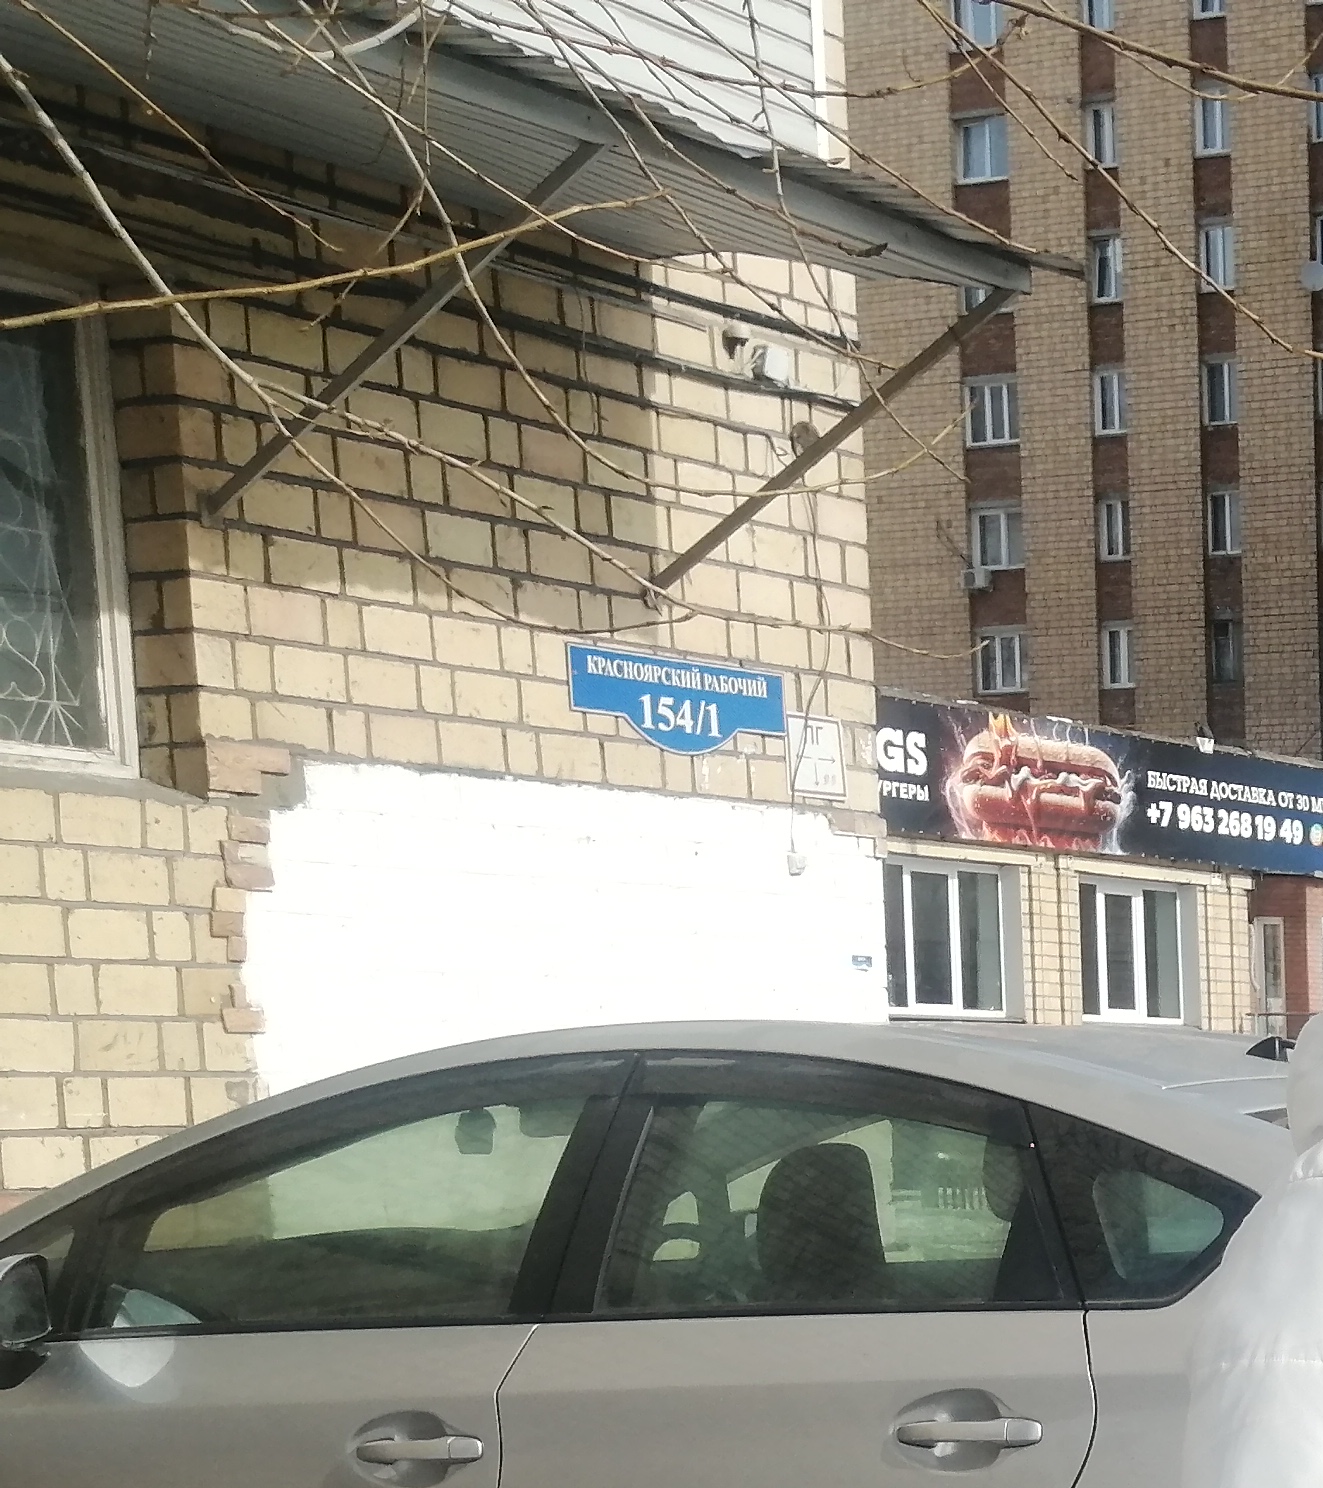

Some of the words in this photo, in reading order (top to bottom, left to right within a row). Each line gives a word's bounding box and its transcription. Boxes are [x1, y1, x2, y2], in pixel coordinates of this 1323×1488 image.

[586, 655, 701, 690] КРАСНОЯРСКИЙ
[703, 675, 768, 698] РАБОЧИЙ
[639, 693, 723, 738] 154/1
[1146, 770, 1208, 797] БЫСТРАЯ
[1209, 781, 1277, 808] ДОСТАВКА
[1277, 792, 1295, 809] ОТ
[1296, 794, 1310, 812] 30
[1146, 801, 1174, 828] +7
[1176, 803, 1215, 834] 963
[1217, 808, 1253, 839] 268
[1254, 814, 1277, 842] 19
[1279, 818, 1304, 845] 49
